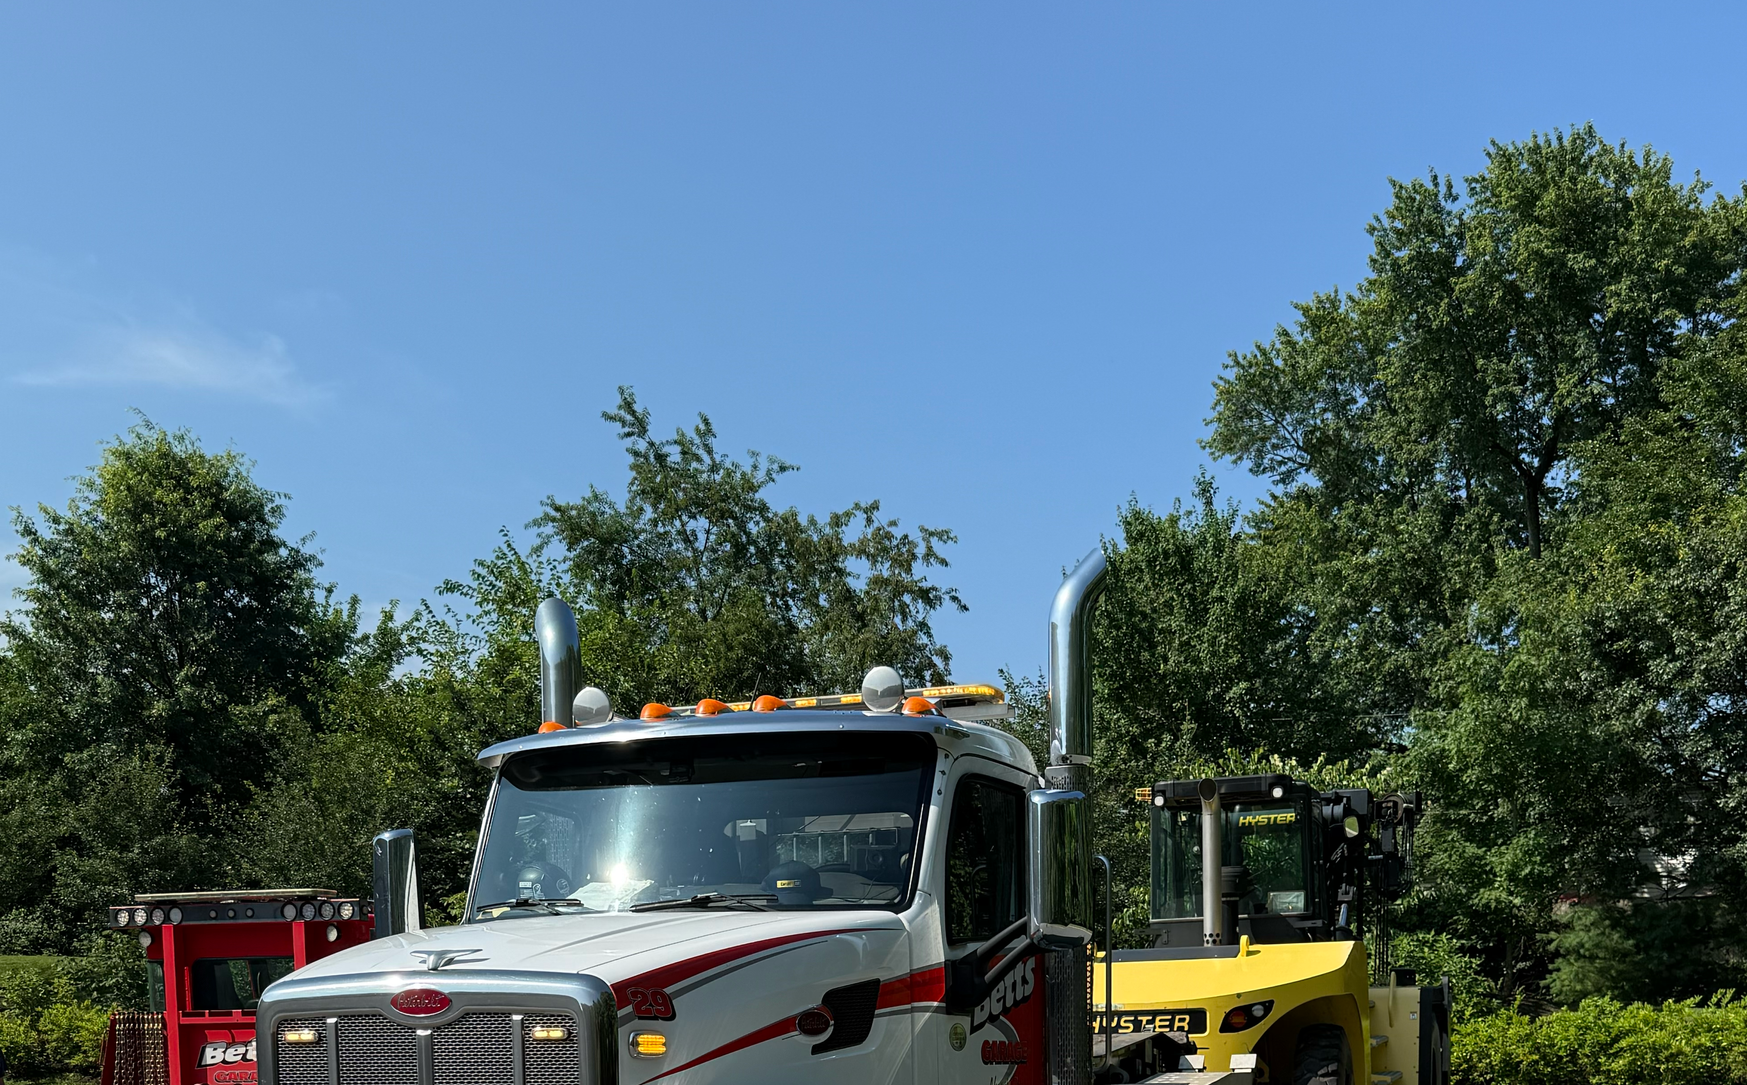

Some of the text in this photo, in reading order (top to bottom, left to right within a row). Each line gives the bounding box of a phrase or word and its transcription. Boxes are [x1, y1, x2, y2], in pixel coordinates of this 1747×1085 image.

[1238, 813, 1296, 827] HYSTER
[627, 988, 676, 1021] 29
[981, 1040, 1028, 1065] GARAGE
